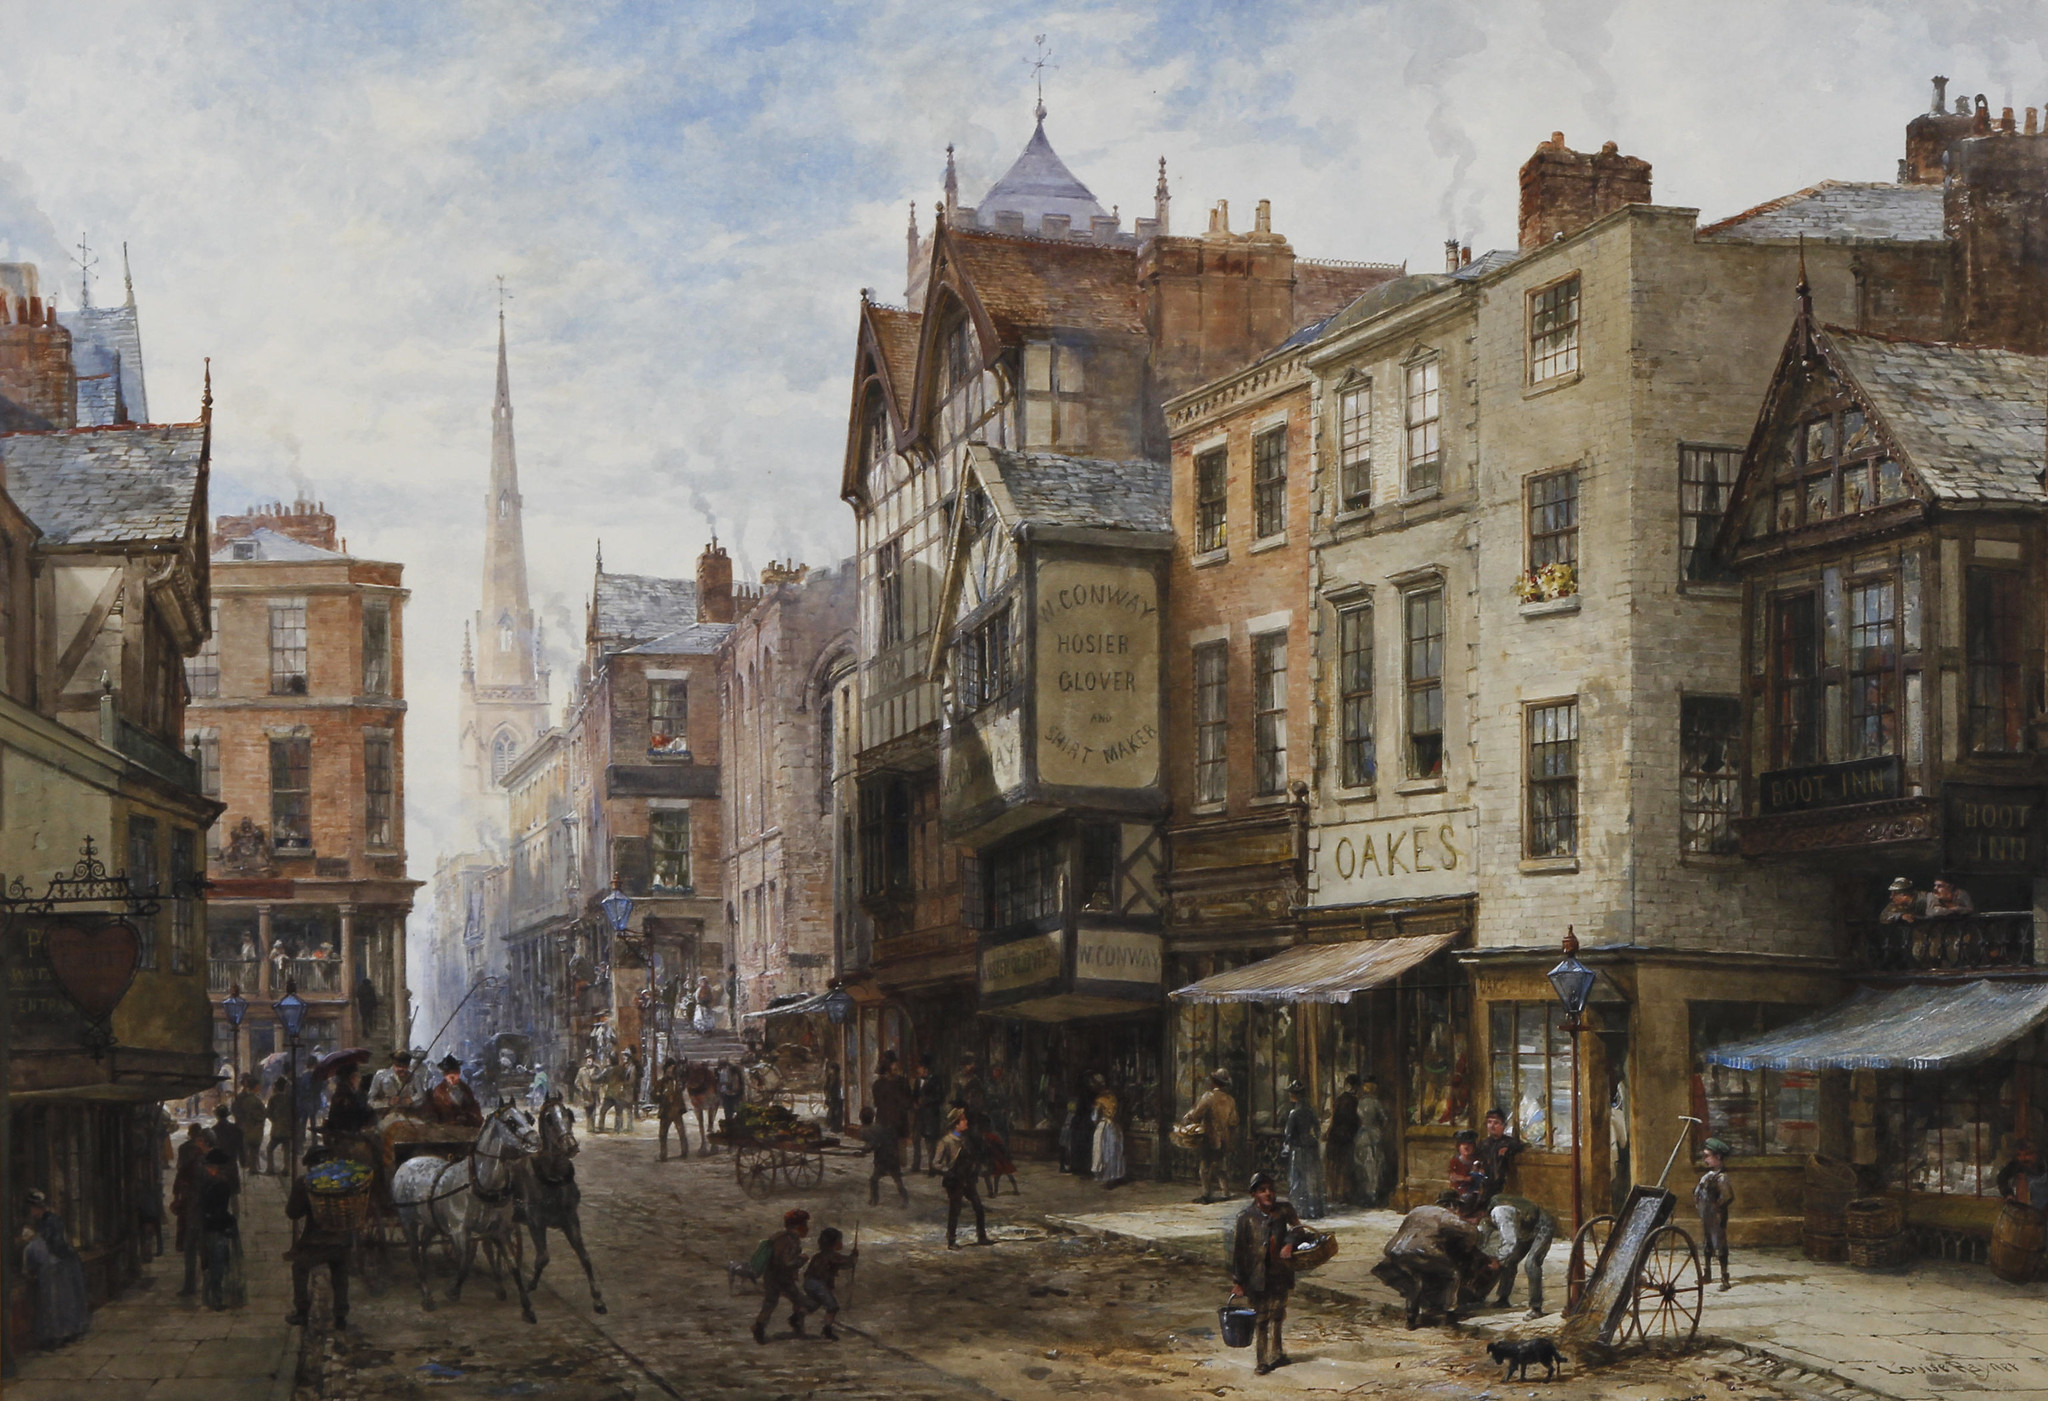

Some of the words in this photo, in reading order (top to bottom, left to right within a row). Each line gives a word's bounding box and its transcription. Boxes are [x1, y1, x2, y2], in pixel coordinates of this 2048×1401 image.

[1057, 633, 1129, 655] HOSIER
[1058, 671, 1136, 692] GLOVER
[1089, 712, 1112, 724] AND
[1044, 725, 1094, 763] SHIRT
[1103, 723, 1157, 764] MAKER
[1771, 775, 1828, 807] BOOT
[1841, 768, 1885, 798] INN
[1964, 802, 2031, 829] BOOT
[1335, 824, 1458, 880] OAKES
[1968, 835, 2028, 862] INN
